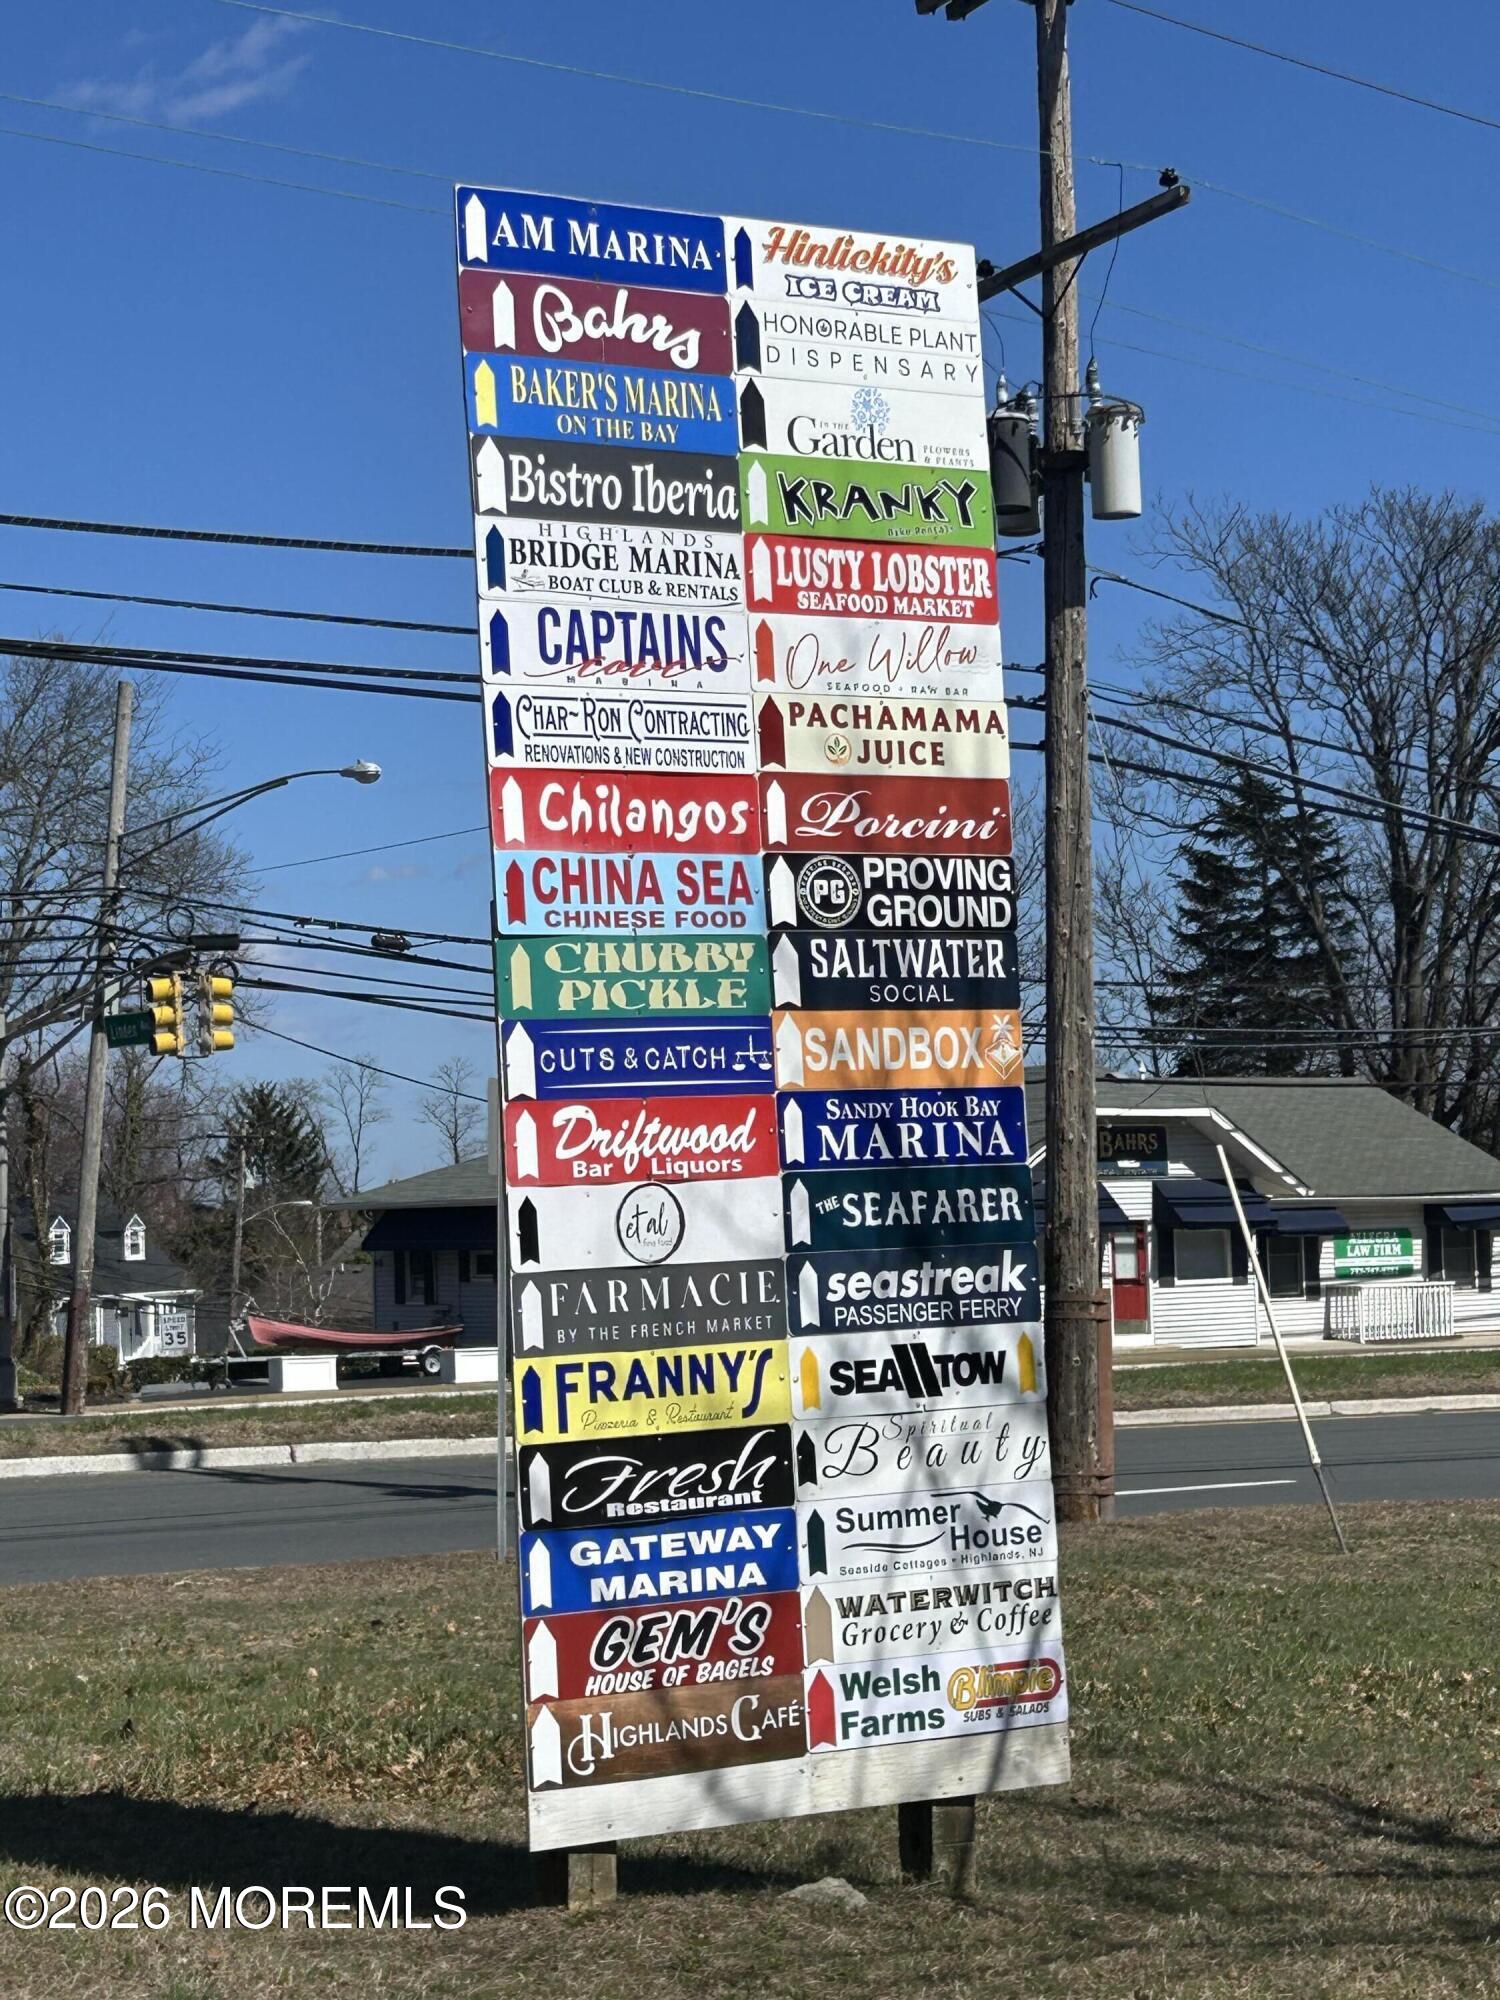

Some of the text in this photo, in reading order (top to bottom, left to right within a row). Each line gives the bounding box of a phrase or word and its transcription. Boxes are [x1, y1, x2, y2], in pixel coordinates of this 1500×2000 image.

[492, 212, 713, 270] AM MARINA
[762, 226, 958, 287] Hinlickity's
[785, 274, 941, 313] ICE CREAM
[533, 284, 701, 369] Bahrs
[764, 312, 977, 353] HONORABLE PLANT
[767, 345, 978, 383] DISPENSARY
[511, 365, 722, 421] BAKER'S MARINA
[557, 414, 679, 444] ON THE BAY
[787, 415, 916, 463] Garden
[923, 445, 970, 456] FLOWERS
[936, 457, 974, 467] PLANTS
[509, 454, 739, 520] Bistro Iberia
[776, 471, 977, 529] KRANKY
[539, 523, 714, 548] HIGHLANDS
[509, 538, 741, 581] BRIDGE MARINA
[775, 545, 992, 599] LUSTY LOBSTER
[549, 575, 738, 601] BOAT CLUB & RENTALS
[797, 592, 974, 618] SEAFOOD MARKET
[537, 606, 728, 673] CAPTAINS
[786, 626, 977, 689] One Willow
[826, 682, 890, 692] SEAFOOD
[945, 687, 968, 696] BAR
[629, 695, 750, 743] CONTRACTING
[788, 702, 1004, 735] PACHAMAMA
[524, 744, 745, 768] RENOVATIONS & NEW CONSTRUCTION
[858, 739, 945, 766] JUICE
[539, 781, 749, 842] Chilangos
[794, 790, 1001, 840] Porcini
[532, 857, 664, 905] CHINA
[677, 859, 754, 905] SEA
[813, 879, 845, 905] PG
[862, 857, 1011, 890] PROVING
[544, 910, 747, 928] CHINESE FOOD
[867, 894, 1011, 928] GROUND
[544, 943, 755, 974] CHUBBY
[810, 938, 1006, 978] SALTWATER
[558, 979, 748, 1010] PICKLE
[869, 985, 954, 1002] SOCIAL
[540, 1045, 726, 1073] CUTS & CATCH
[805, 1026, 984, 1071] SANDBOX
[826, 1096, 1001, 1120] SANDY HOOK BAY
[553, 1105, 757, 1174] Driftwood
[816, 1120, 1014, 1161] MARINA
[1099, 1131, 1158, 1158] BAHRS
[573, 1157, 743, 1178] Bar Liquors
[626, 1202, 668, 1239] et al
[816, 1187, 1023, 1227] THE SEAFARER
[1346, 1243, 1401, 1257] LAW FIRM
[550, 1270, 777, 1316] FARMACIE
[826, 1250, 1027, 1301] seastreak
[557, 1315, 773, 1343] BY THE FRENCH MARKET
[834, 1297, 1022, 1326] PASSENGER FERRY
[165, 1332, 186, 1345] 35
[555, 1348, 773, 1434] FRANNY'S
[829, 1350, 1006, 1396] SEA TOW
[666, 1402, 734, 1424] Restaurant
[882, 1412, 993, 1442] Spiritual
[822, 1422, 1046, 1480] Beauty
[561, 1429, 777, 1513] Fresh
[607, 1490, 762, 1517] Restaurant
[836, 1503, 961, 1533] Summer
[570, 1523, 782, 1566] GATEWAY
[950, 1523, 1042, 1550] House
[839, 1565, 888, 1575] Seaside
[893, 1559, 947, 1570] Cottages
[1029, 1547, 1043, 1557] NJ
[591, 1562, 767, 1602] MARINA
[836, 1576, 1058, 1619] WATERWITCH
[589, 1596, 772, 1672] GEM'S
[841, 1603, 1052, 1647] Grocery & Coffee
[585, 1656, 774, 1696] HOUSE OF BAGELS
[839, 1664, 941, 1701] Welsh
[947, 1665, 1054, 1711] Blimpie
[840, 1707, 945, 1741] Farms
[963, 1702, 1050, 1723] SUBS & SALADS
[568, 1694, 800, 1776] HIGHLANDS CAFÉ
